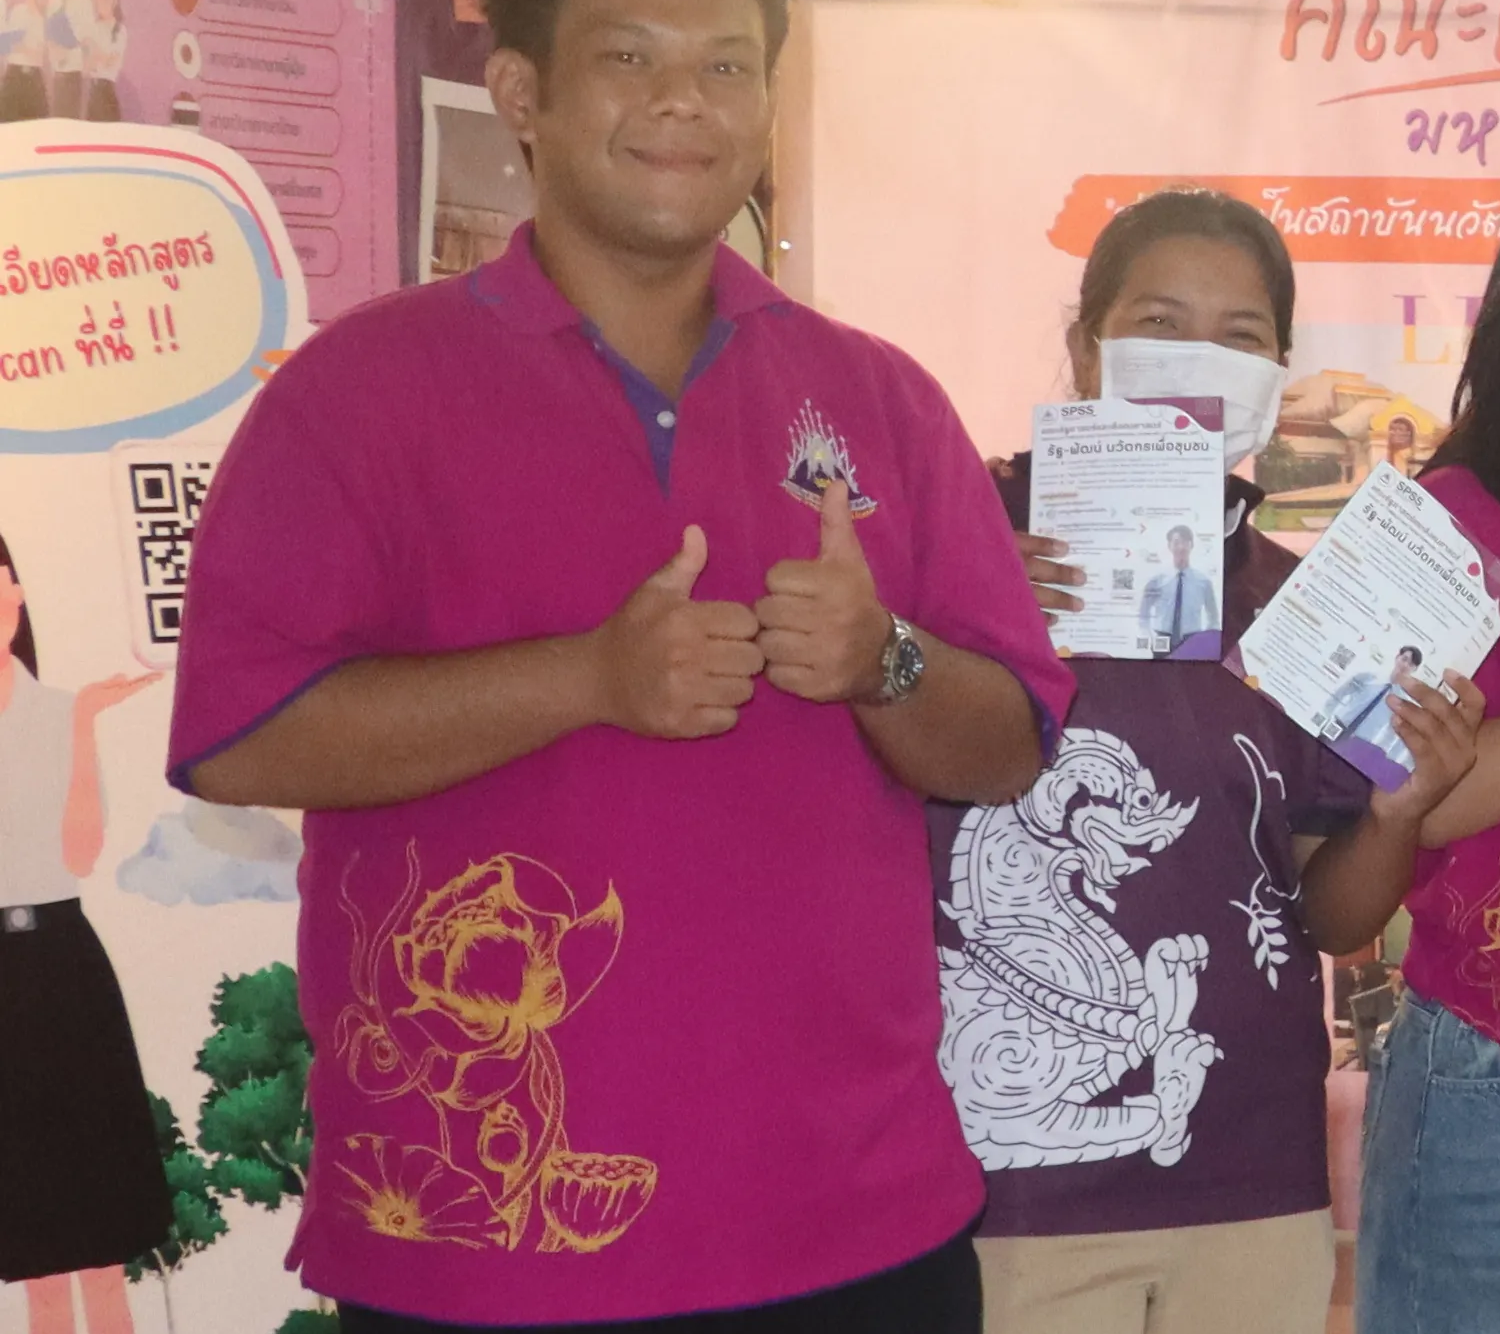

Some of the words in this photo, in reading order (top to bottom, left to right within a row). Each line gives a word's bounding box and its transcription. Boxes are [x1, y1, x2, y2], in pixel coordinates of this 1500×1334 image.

[75, 300, 135, 368] ที่นี่
[1061, 405, 1096, 418] SPSS
[1396, 480, 1424, 508] SPSS
